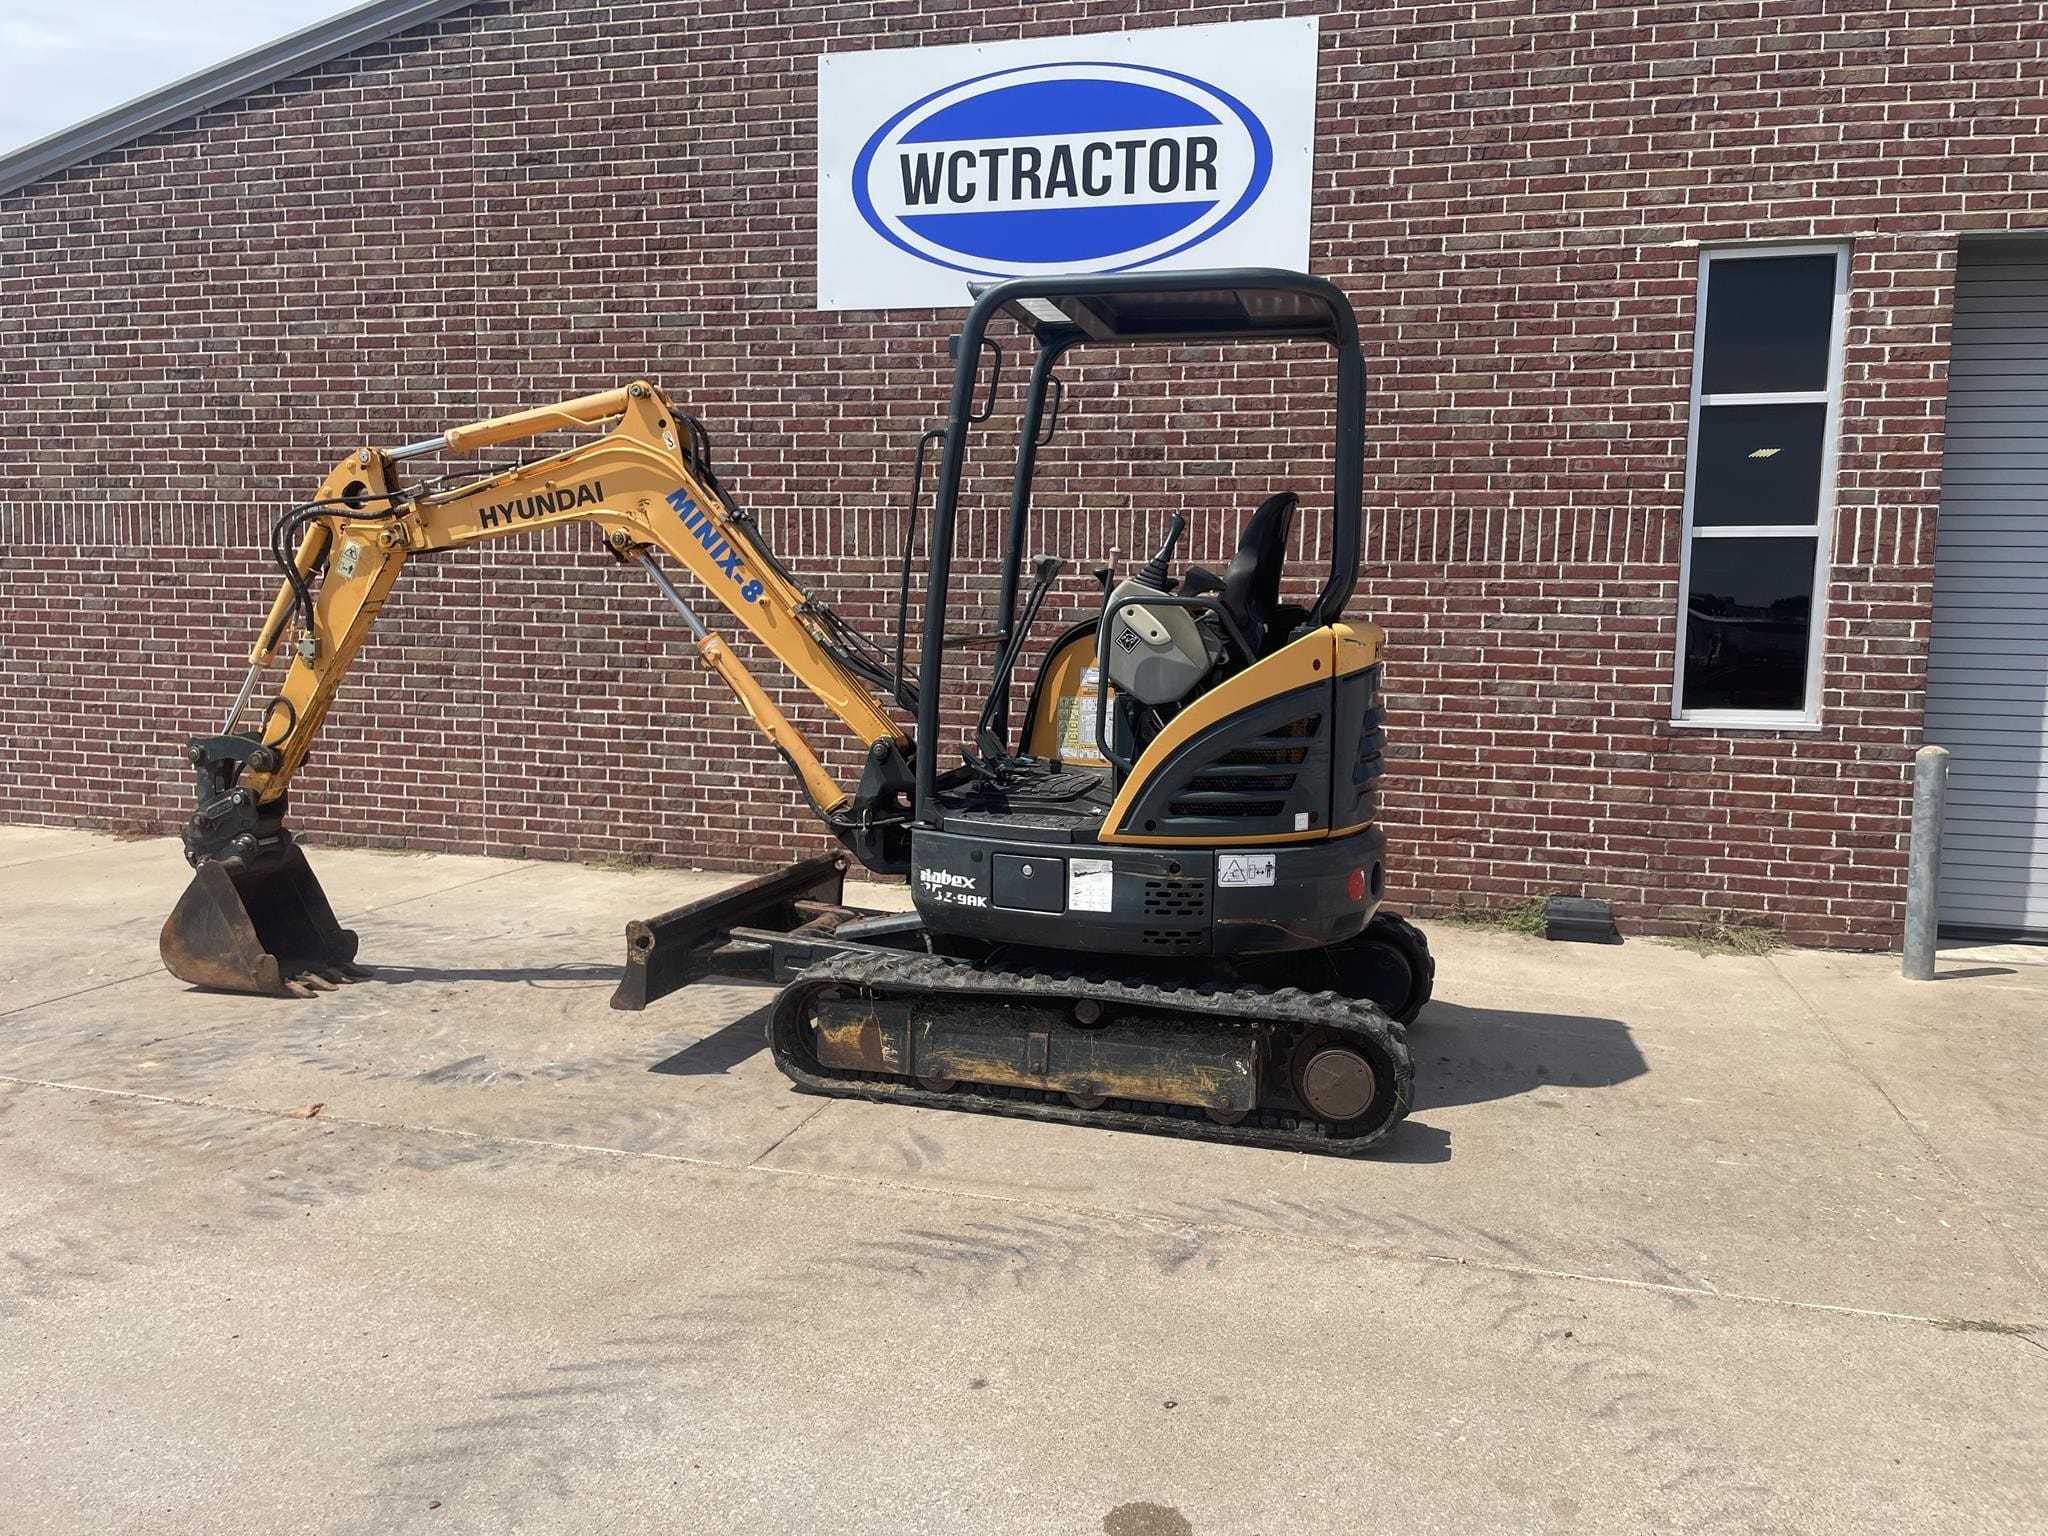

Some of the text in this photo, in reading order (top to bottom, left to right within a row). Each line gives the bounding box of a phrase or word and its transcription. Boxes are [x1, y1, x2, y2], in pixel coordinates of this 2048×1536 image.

[900, 135, 1218, 206] WCTRACTOR
[479, 481, 604, 529] HYUNDAI
[665, 487, 764, 603] MINIX-8
